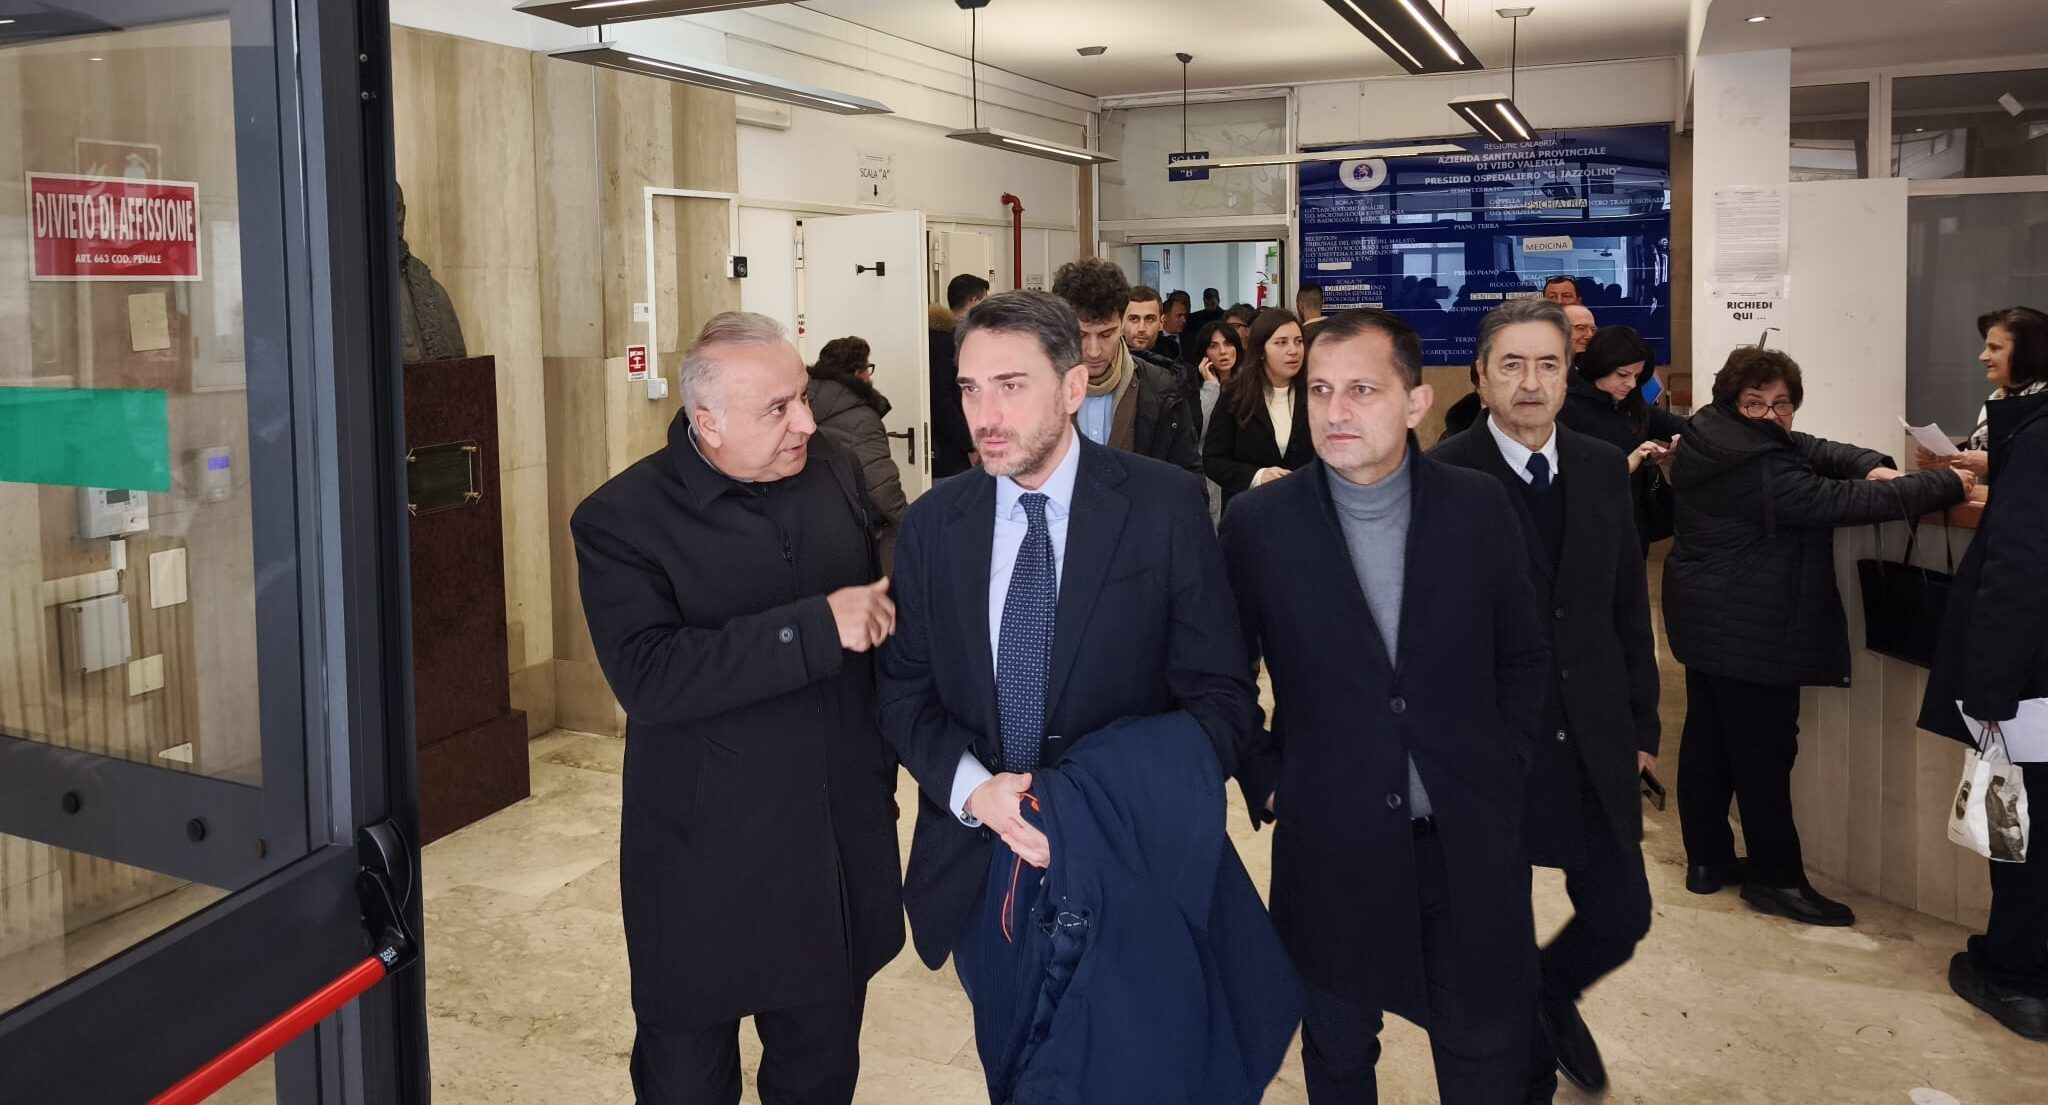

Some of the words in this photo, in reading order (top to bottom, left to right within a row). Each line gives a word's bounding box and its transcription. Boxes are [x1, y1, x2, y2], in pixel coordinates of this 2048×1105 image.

[1483, 142, 1518, 150] REGIONE
[1520, 140, 1557, 148] CALABRIA
[1438, 153, 1480, 164] AZIENDA
[1482, 151, 1535, 162] SANITARIA
[1538, 147, 1607, 159] PROVINCIALE
[1476, 163, 1489, 171] DI
[1491, 161, 1519, 170] VIBO
[1521, 158, 1565, 168] VALENTIA
[860, 167, 878, 179] SCALA
[1424, 174, 1471, 185] PRESIDIO
[1473, 171, 1541, 183] OSPEDALIERO
[1542, 170, 1559, 179] "G.
[1560, 167, 1622, 179] IAZZOLINO"
[1525, 199, 1588, 209] PSICHIATRIA
[35, 192, 95, 240] DIVIETO
[99, 195, 116, 241] DI
[119, 196, 194, 242] AFFISSIONE
[1525, 241, 1568, 251] MEDICINA
[94, 254, 110, 264] 663
[111, 254, 131, 264] COD.
[133, 254, 162, 264] PENALE
[1726, 301, 1773, 310] RICHIEDI
[1733, 312, 1753, 321] QUI
